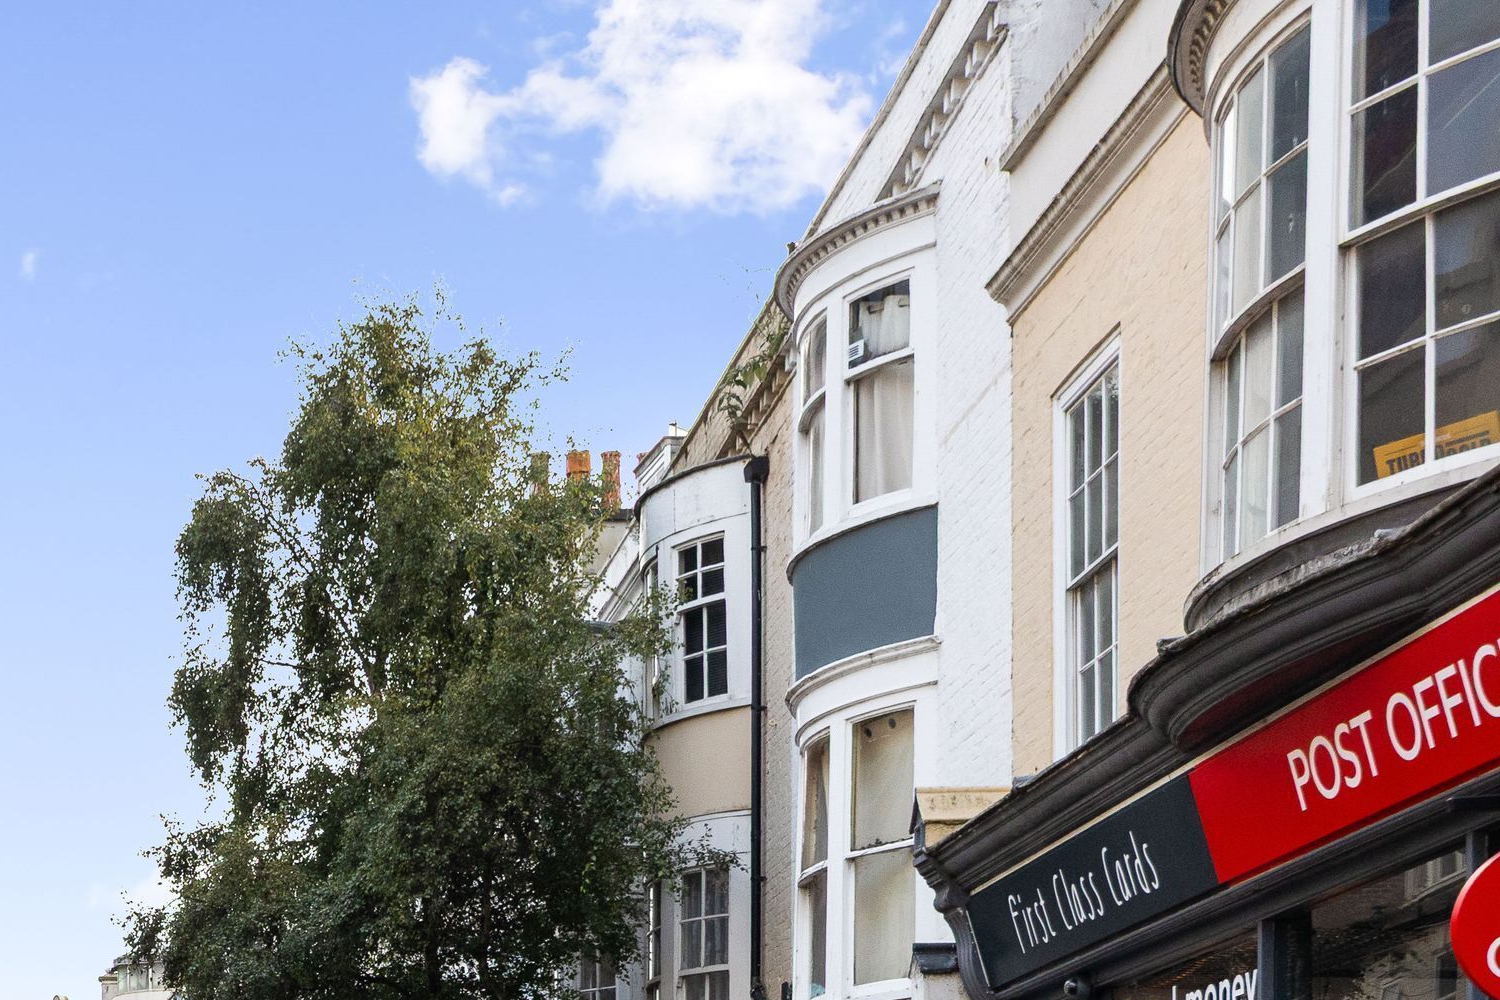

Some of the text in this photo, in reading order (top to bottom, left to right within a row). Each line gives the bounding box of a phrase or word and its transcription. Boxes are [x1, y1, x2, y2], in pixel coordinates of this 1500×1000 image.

[1287, 637, 1500, 812] POST OFFIC
[1008, 831, 1160, 954] First Class Cards
